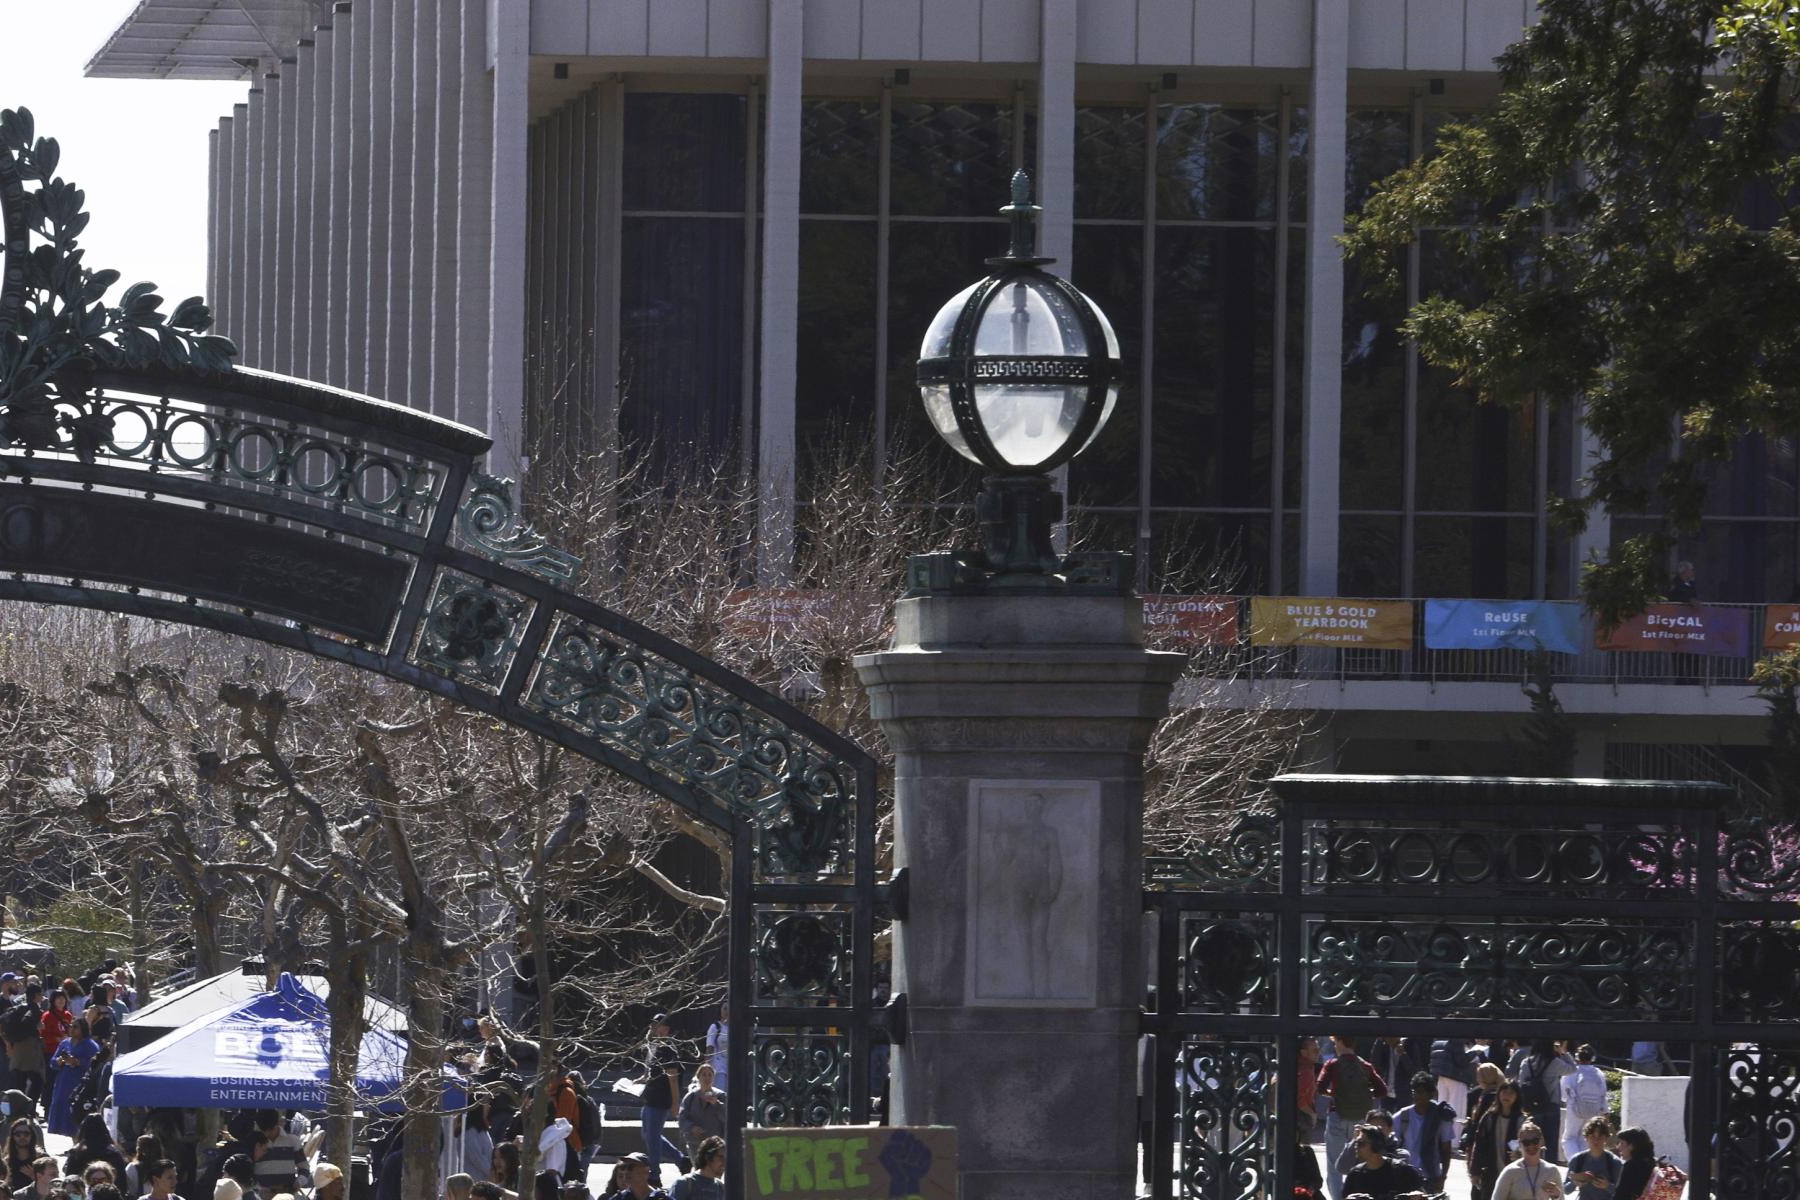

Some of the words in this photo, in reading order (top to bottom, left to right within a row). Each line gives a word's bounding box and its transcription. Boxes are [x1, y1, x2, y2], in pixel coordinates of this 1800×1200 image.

[1162, 602, 1224, 612] STUDENT
[1287, 605, 1321, 616] BLUE
[1325, 606, 1334, 616] &
[1338, 606, 1377, 618] GOLD
[1484, 612, 1528, 623] ReUSE
[1647, 615, 1703, 628] BicyCAL
[1294, 618, 1368, 629] YEARBOOK
[1642, 630, 1656, 638] 1st
[1658, 631, 1684, 639] Floor
[1688, 632, 1705, 640] MLK
[210, 1077, 279, 1087] BUSINESS
[210, 1089, 328, 1101] ENTERTAINMENT
[750, 1136, 871, 1196] FREE
